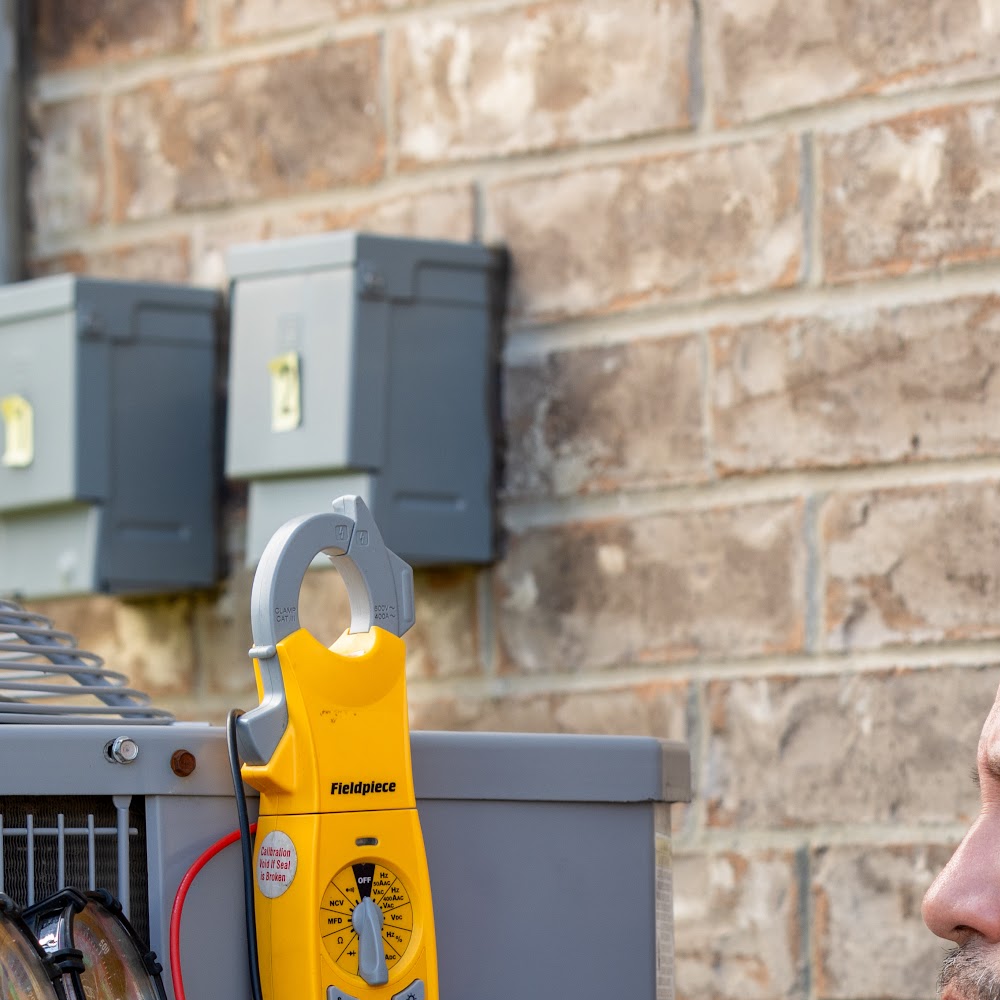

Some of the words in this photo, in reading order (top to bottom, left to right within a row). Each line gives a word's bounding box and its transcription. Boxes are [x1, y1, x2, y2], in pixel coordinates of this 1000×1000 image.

[274, 607, 297, 615] CLAMP
[330, 781, 397, 796] Fieldpiece
[260, 846, 291, 857] Calibration
[276, 859, 291, 870] Seal
[265, 871, 286, 882] Broken
[357, 877, 372, 885] OFF
[327, 917, 343, 925] MFD
